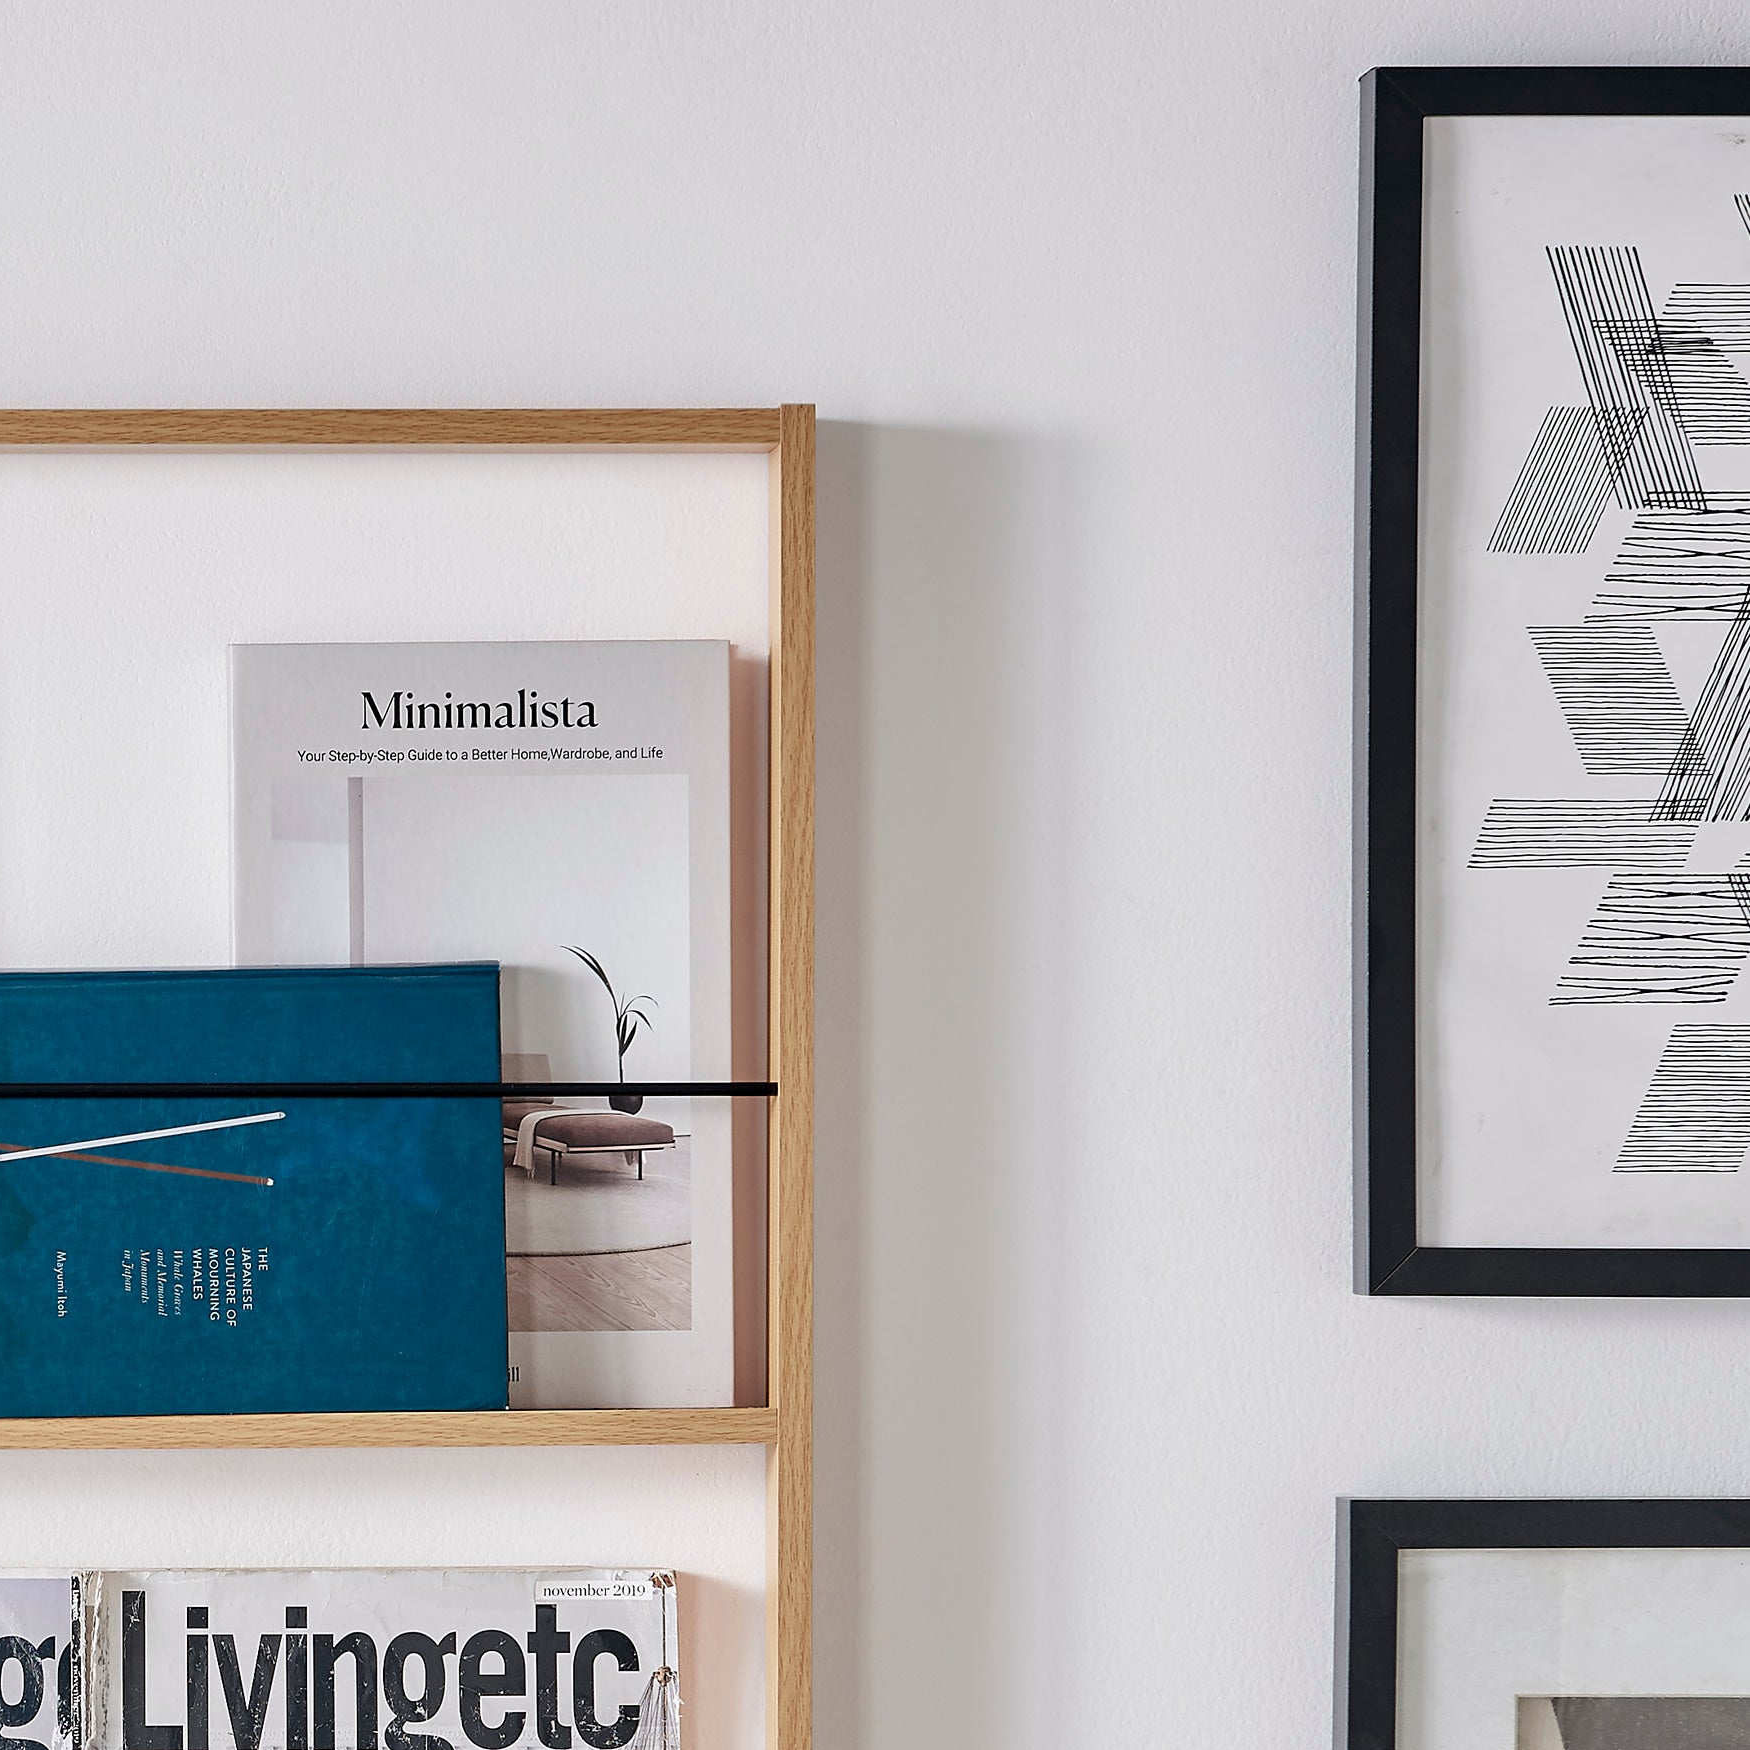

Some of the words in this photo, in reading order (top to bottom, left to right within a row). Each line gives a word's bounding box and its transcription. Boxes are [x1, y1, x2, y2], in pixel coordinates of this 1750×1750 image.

[361, 688, 599, 729] Minimalista
[297, 750, 326, 762] Your
[328, 749, 405, 764] Step-by-Step
[407, 749, 443, 761] Guide
[446, 750, 458, 761] to
[461, 752, 468, 760] a
[472, 749, 508, 761] Better
[615, 747, 637, 759] and
[641, 747, 663, 759] Life
[123, 1250, 134, 1260] in
[157, 1248, 167, 1268] and
[172, 1250, 184, 1281] Whale
[258, 1247, 268, 1271] THE
[53, 1250, 68, 1294] Mayumi
[122, 1261, 134, 1292] Japan
[140, 1249, 151, 1304] Monuments
[192, 1248, 203, 1300] WHALES
[209, 1248, 220, 1321] MOURNING
[224, 1248, 236, 1305] CULTURE
[242, 1247, 253, 1310] JAPANESE
[56, 1296, 68, 1317] Itoh
[157, 1270, 169, 1317] Memorial
[226, 1309, 237, 1327] OF
[543, 1583, 610, 1596] november
[613, 1584, 646, 1597] 2019
